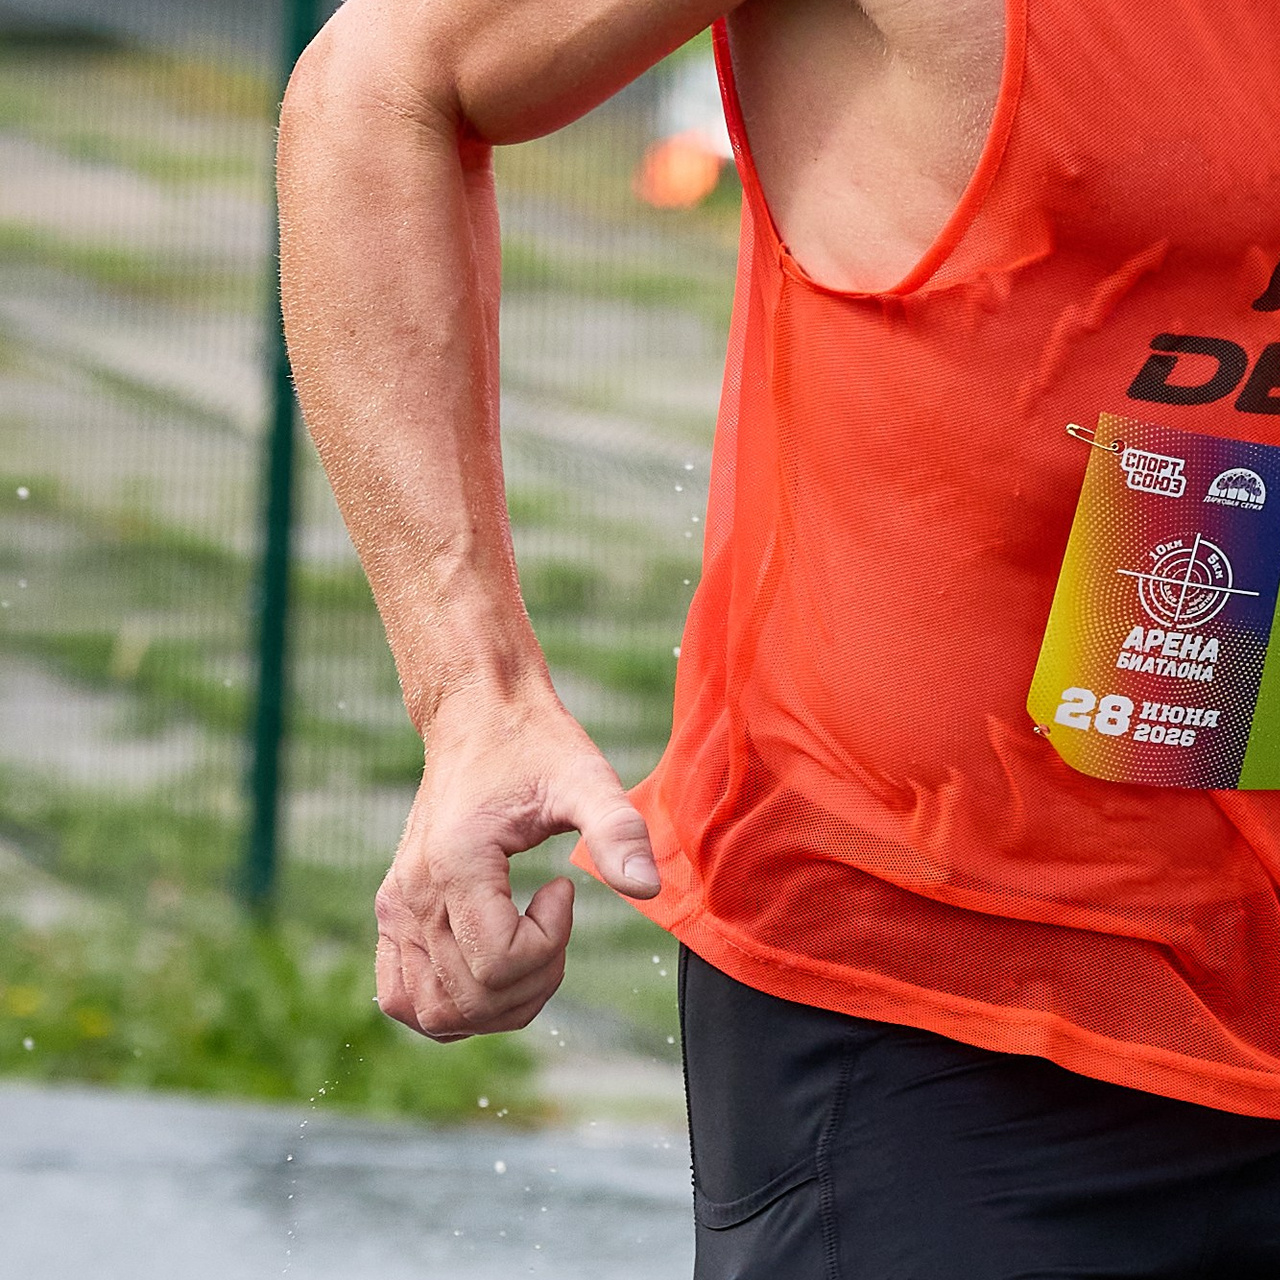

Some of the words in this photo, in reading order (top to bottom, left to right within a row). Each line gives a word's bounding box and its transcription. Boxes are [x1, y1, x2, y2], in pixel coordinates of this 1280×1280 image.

[1125, 452, 1181, 477] СПОРТ
[1131, 471, 1183, 494] СОЮЗ
[1122, 625, 1219, 663] АРЕНА
[1116, 651, 1215, 682] БИАТЛОНА
[1054, 686, 1135, 737] 28
[1133, 723, 1197, 748] 2026
